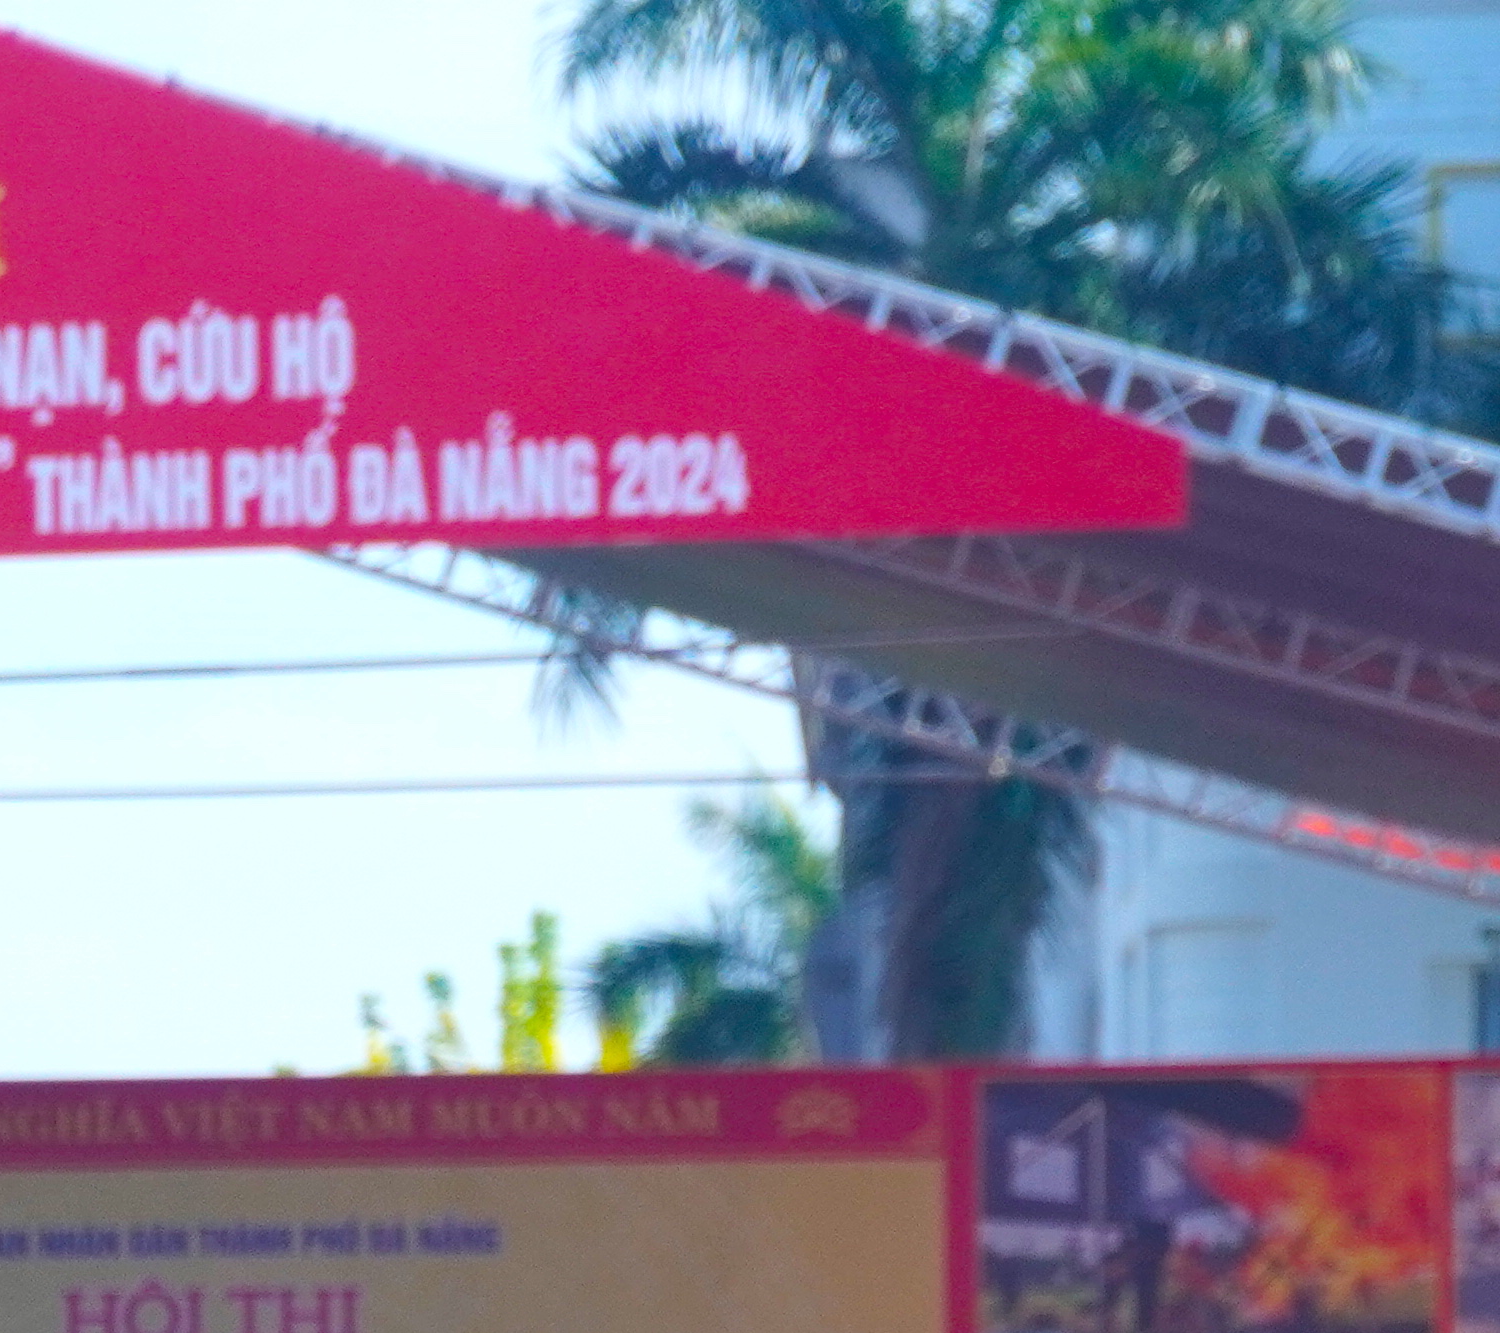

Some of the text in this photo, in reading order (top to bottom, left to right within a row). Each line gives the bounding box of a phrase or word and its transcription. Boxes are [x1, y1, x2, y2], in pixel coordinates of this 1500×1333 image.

[136, 298, 258, 404] CỨU
[272, 293, 355, 416] HỘ
[28, 435, 211, 535] THÀNH
[223, 418, 338, 529] PHỐ
[347, 425, 430, 527] ĐÀ
[438, 409, 598, 522] NẴNG
[608, 431, 749, 517] 2024
[161, 1090, 286, 1151] VIỆT
[297, 1095, 414, 1140] NAM
